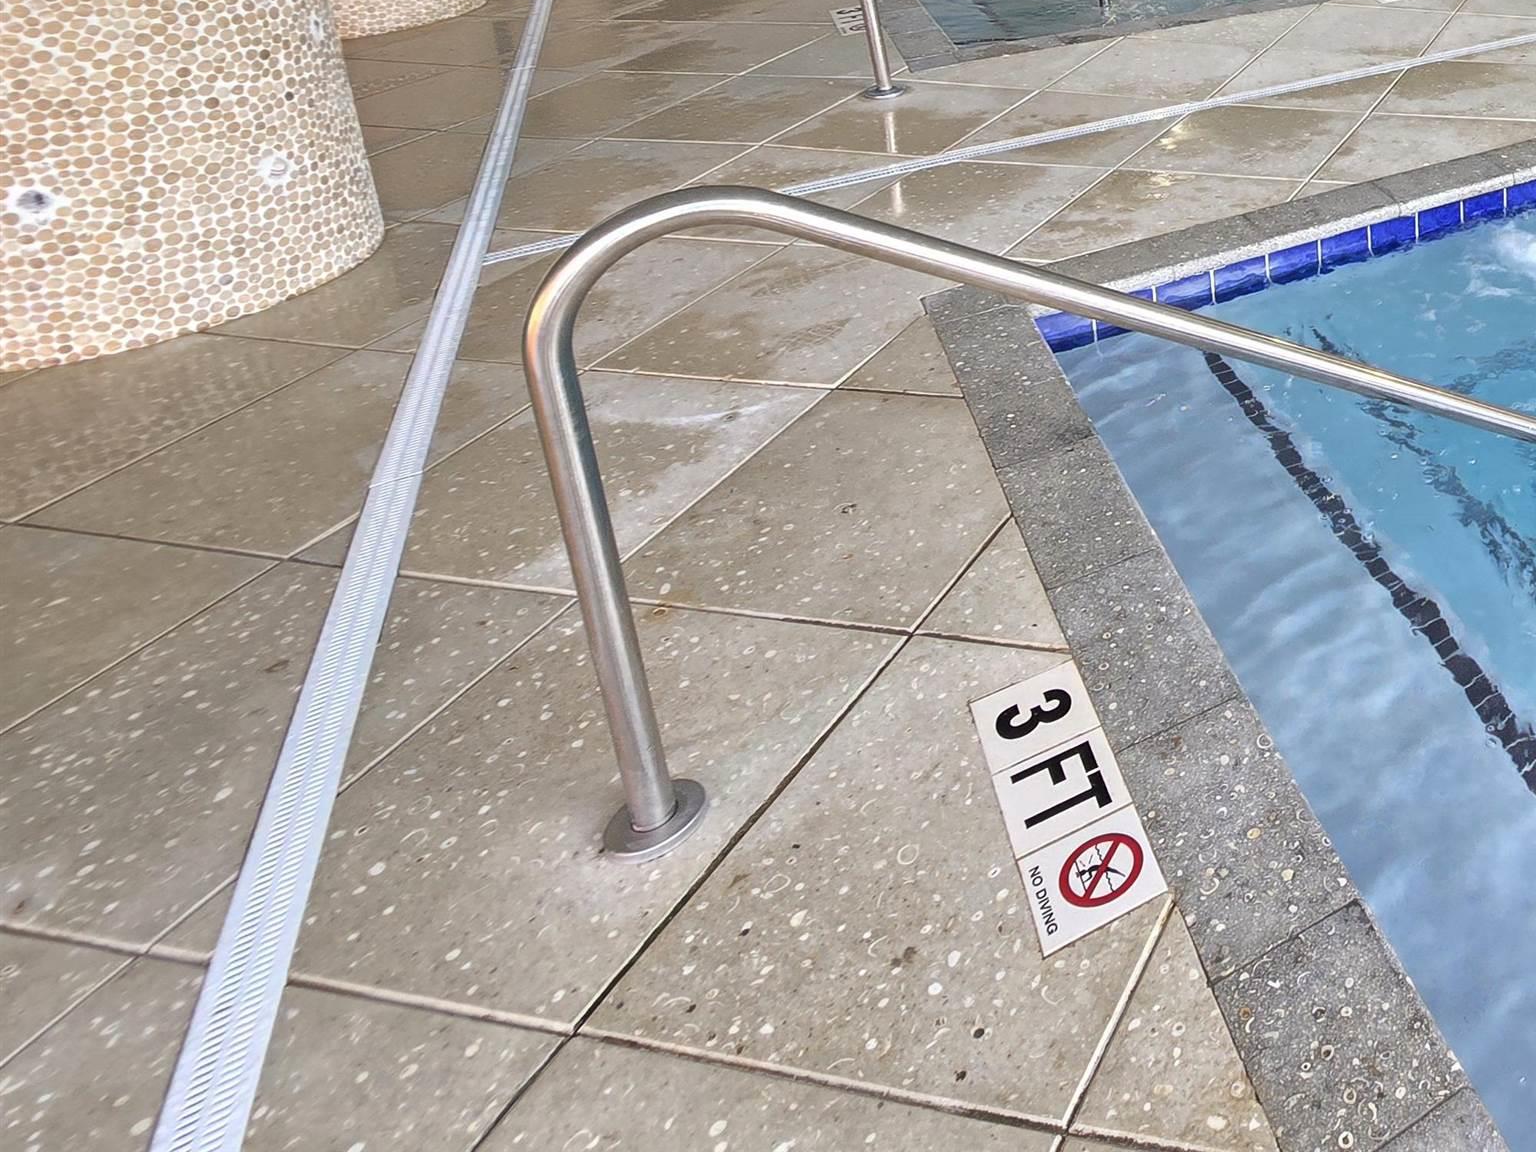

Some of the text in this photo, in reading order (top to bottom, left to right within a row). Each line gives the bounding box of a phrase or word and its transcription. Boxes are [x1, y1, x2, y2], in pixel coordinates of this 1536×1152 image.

[995, 688, 1112, 830] 3 FT
[1028, 866, 1058, 937] NO DIVING
